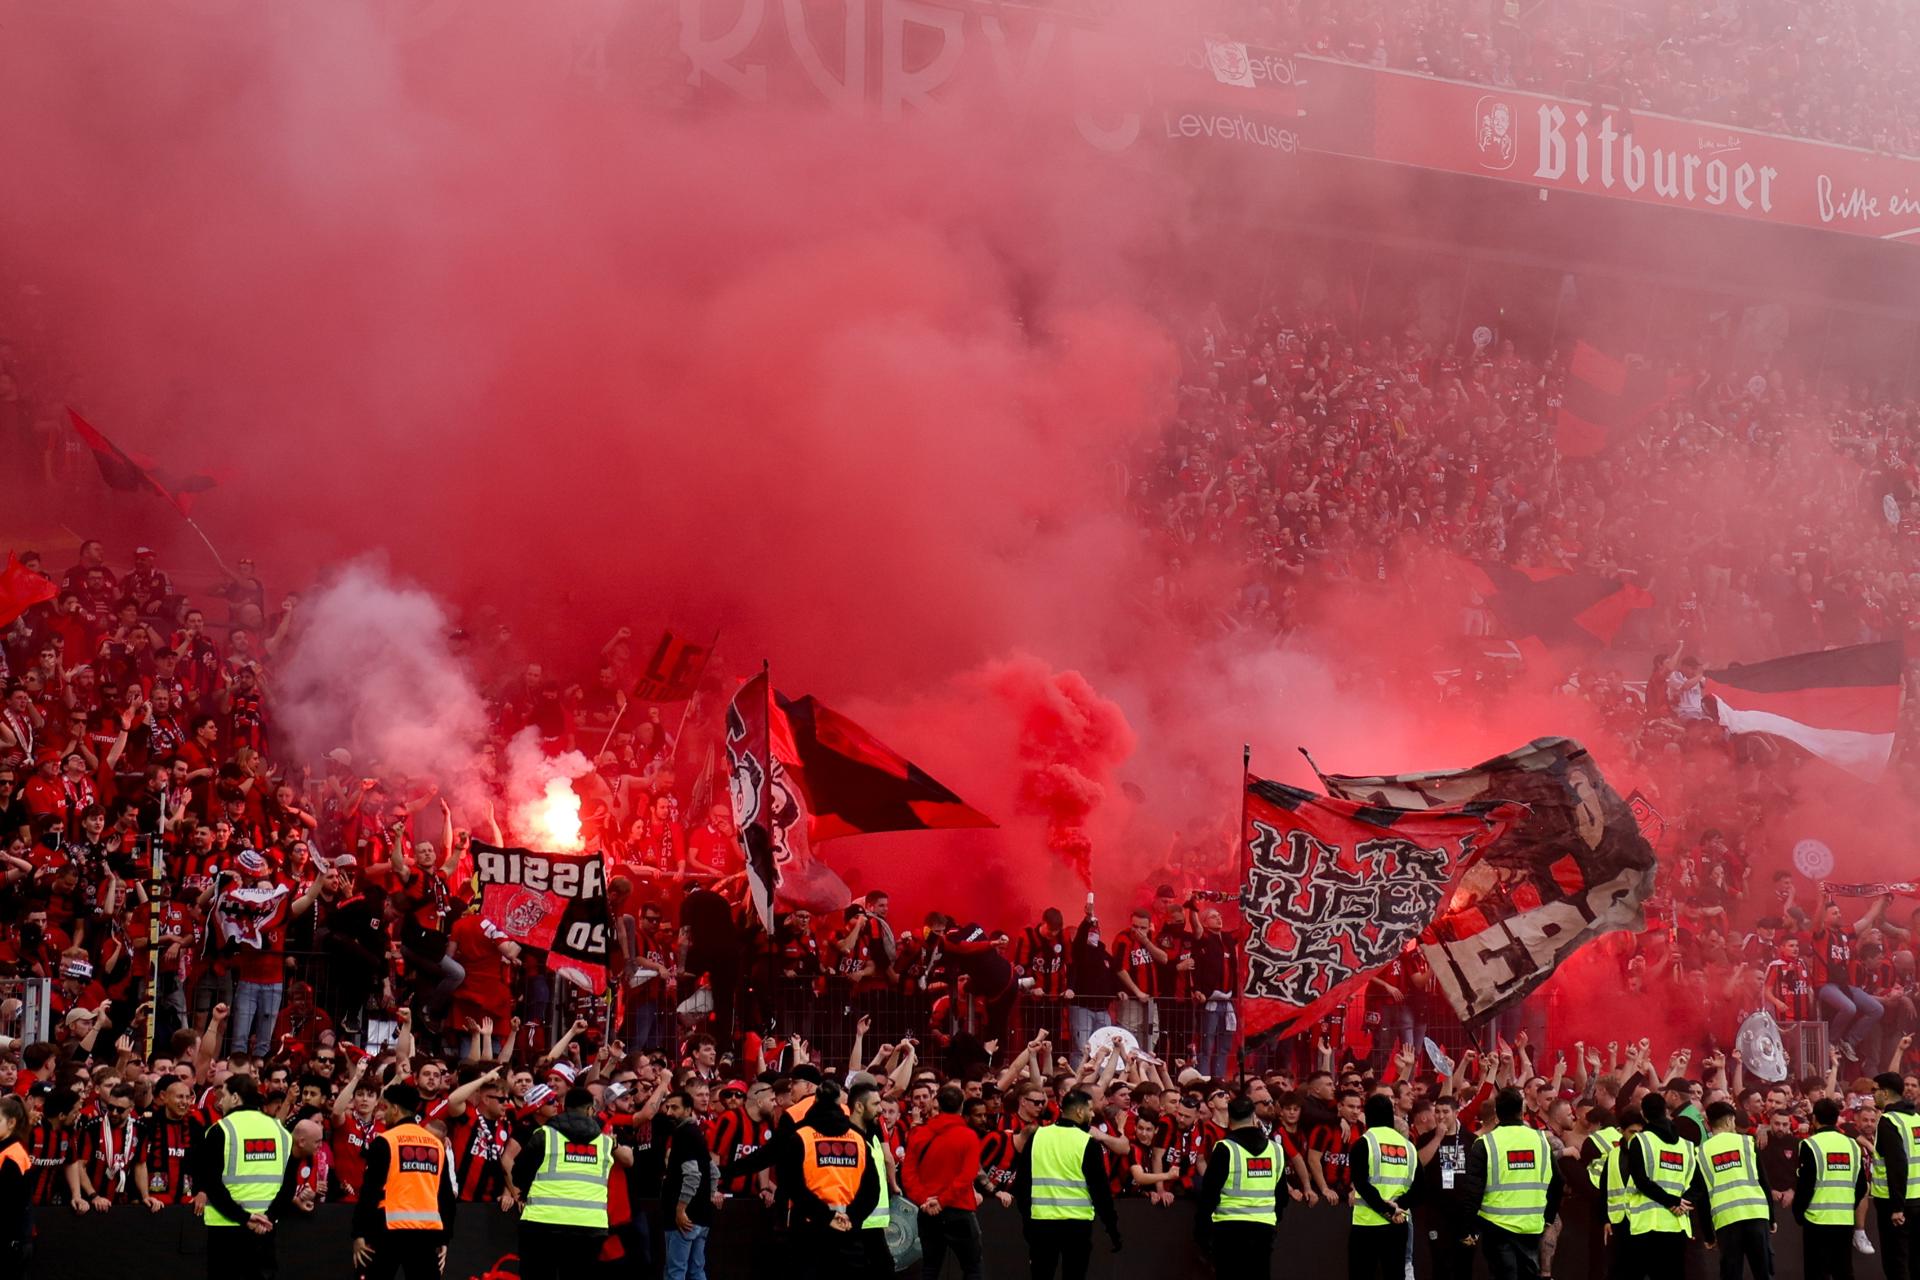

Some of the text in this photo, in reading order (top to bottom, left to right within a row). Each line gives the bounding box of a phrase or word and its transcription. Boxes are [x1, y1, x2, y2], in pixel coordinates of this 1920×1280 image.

[1533, 103, 1778, 213] Bitburger
[1817, 174, 1881, 222] Bitte
[245, 1152, 276, 1161] SECURITAS
[566, 1154, 597, 1164] SECURITAS
[819, 1156, 856, 1166] SECURITAS
[402, 1160, 438, 1173] SECURITAS
[1714, 1160, 1742, 1172] SECURITAS
